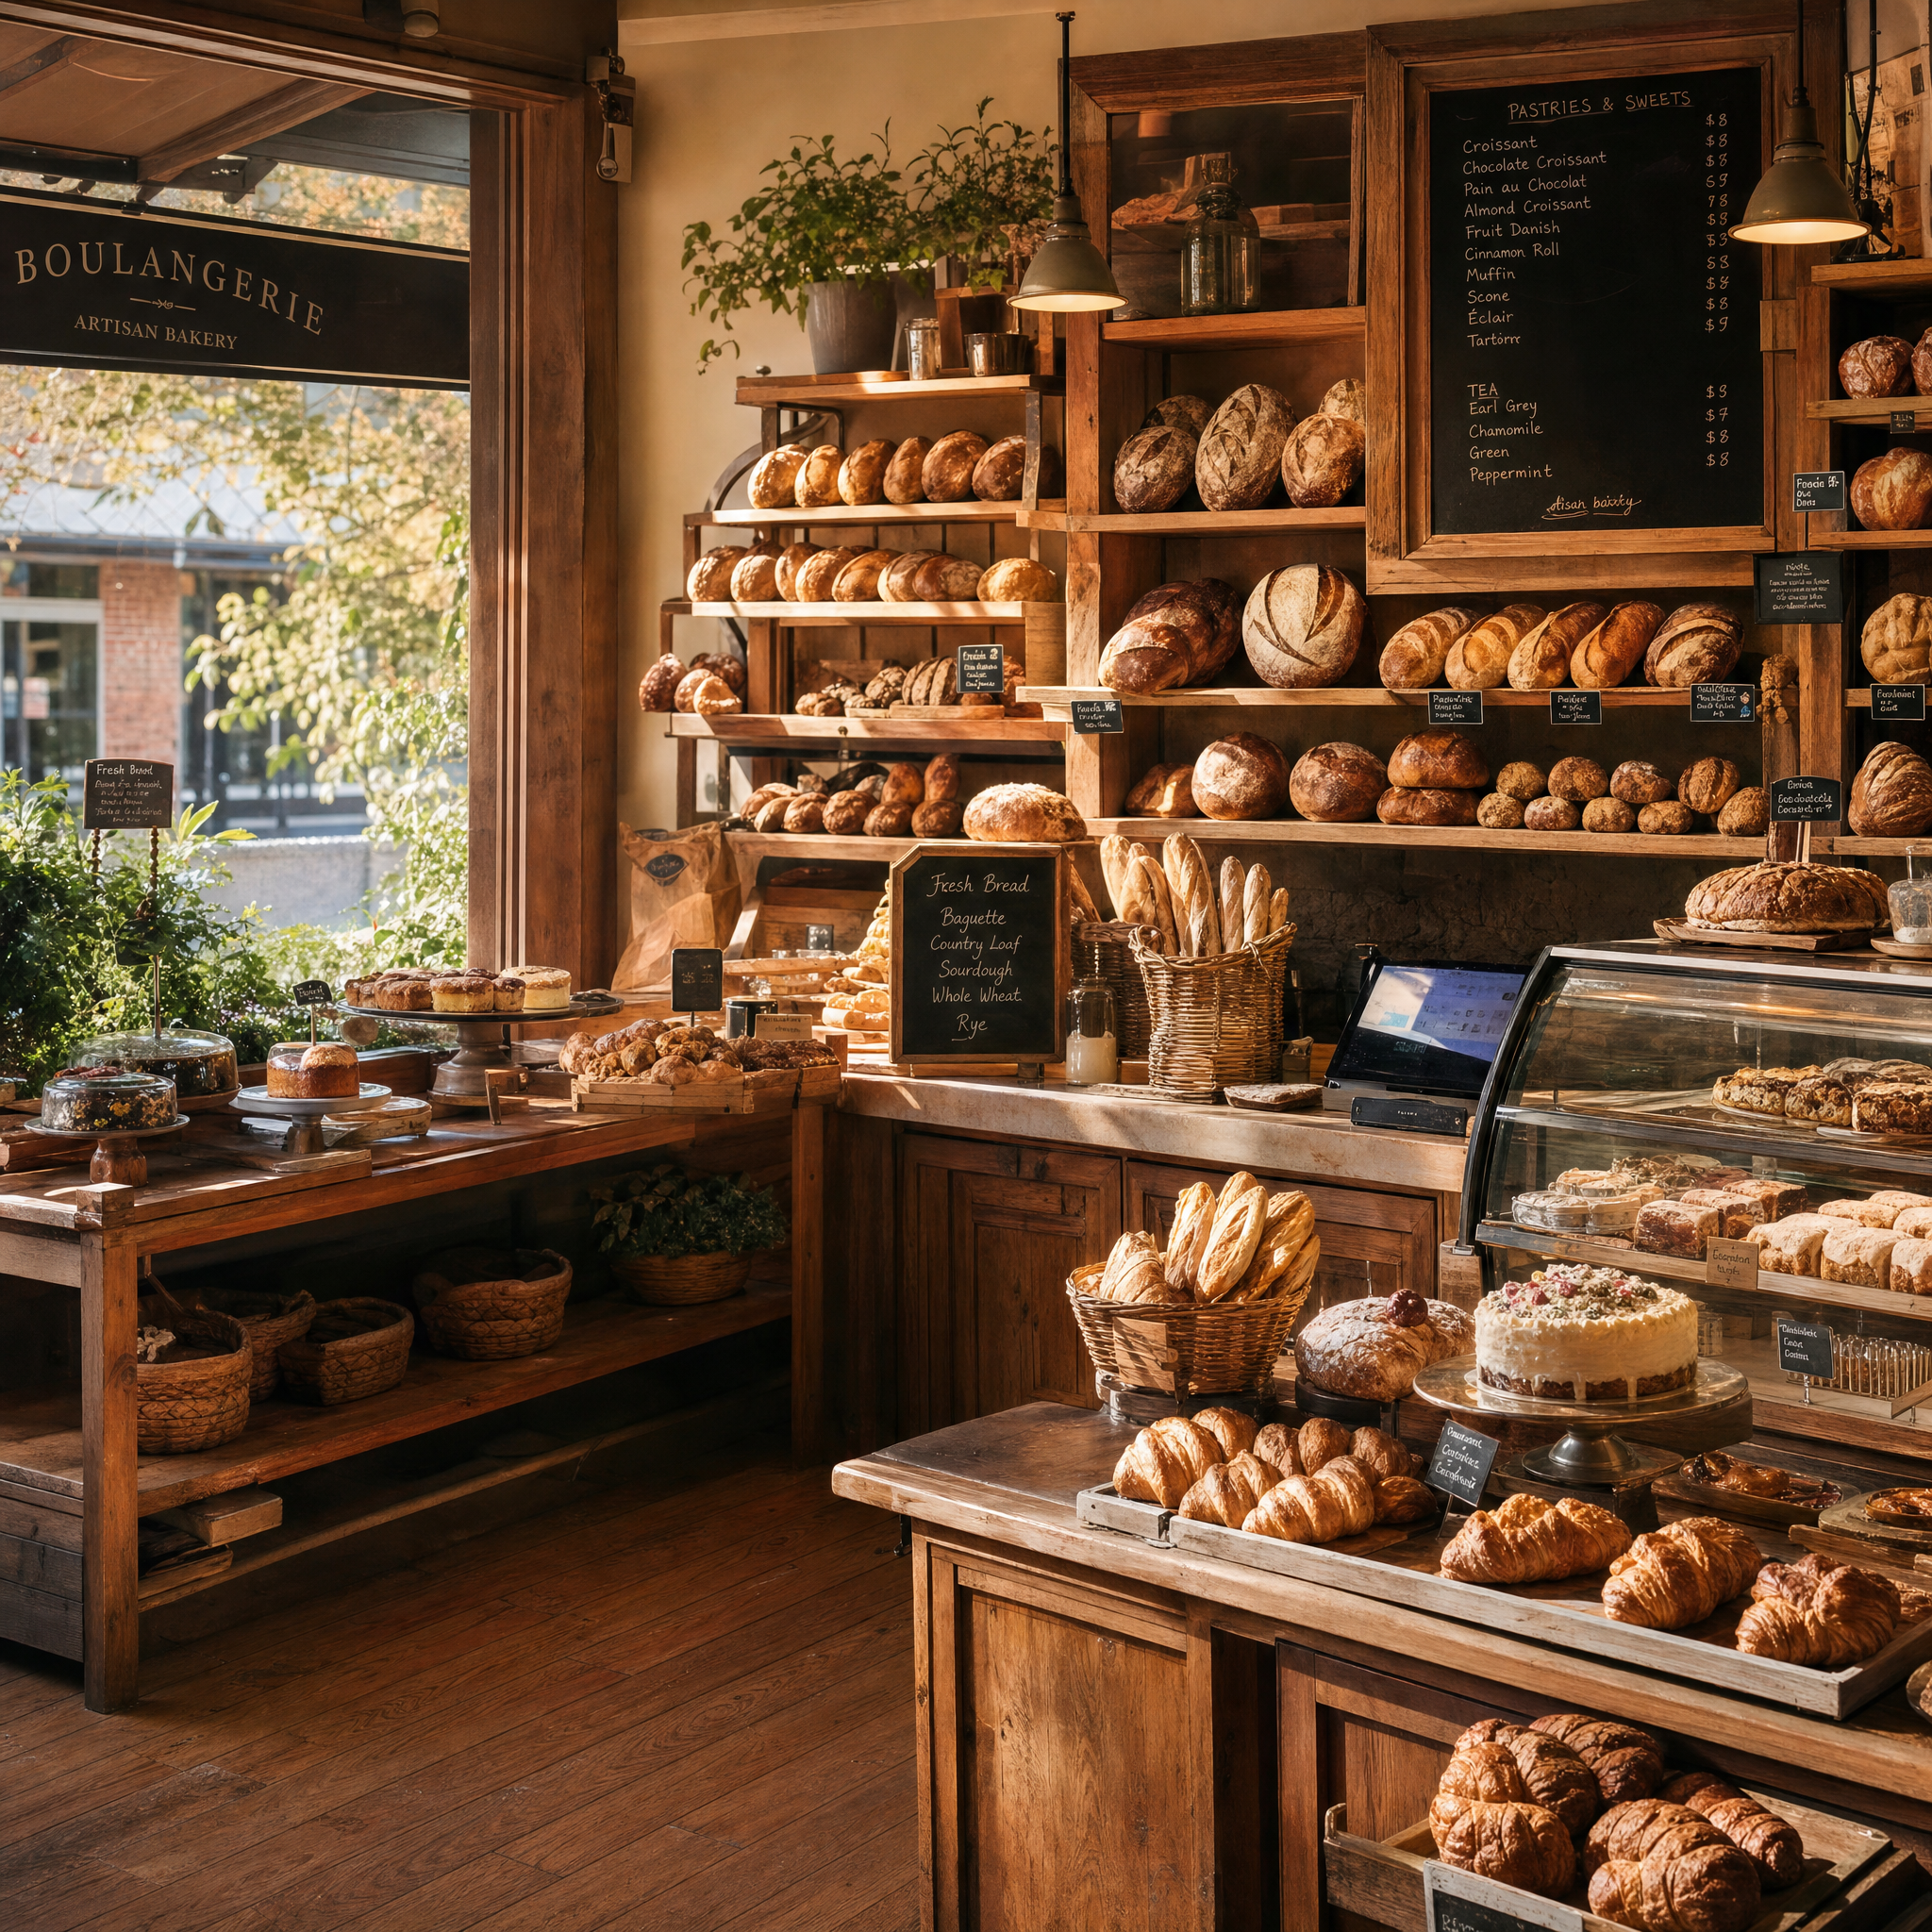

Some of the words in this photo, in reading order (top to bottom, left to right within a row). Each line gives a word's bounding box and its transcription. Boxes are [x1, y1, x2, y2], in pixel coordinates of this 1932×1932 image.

[1508, 98, 1591, 120] PASTRIES
[1604, 97, 1613, 110] &
[1625, 91, 1690, 110] SWEETS
[1463, 136, 1538, 153] Croissant
[1463, 158, 1529, 175] Chocolate
[1537, 151, 1607, 168] Croissant
[1465, 182, 1493, 196] Pain
[1502, 184, 1520, 192] au
[1529, 175, 1586, 192] Chocolat
[1464, 201, 1515, 217] Almond
[1524, 196, 1591, 213] Croissant
[1466, 225, 1502, 239] Fruit
[1510, 220, 1559, 236] Danish
[1465, 248, 1525, 260] Cinnamon
[1533, 242, 1558, 257] Roll
[1467, 267, 1515, 281] Muffin
[14, 242, 324, 336] BOULANGERIE
[1468, 291, 1509, 304] Scone
[1469, 308, 1513, 325] Éclair
[75, 315, 158, 339] ARTISAN
[166, 327, 237, 349] BAKERY
[1467, 382, 1499, 396] TEA
[1469, 399, 1497, 415] Earl
[1507, 399, 1536, 419] Grey
[1470, 421, 1543, 438] Chamomile
[1470, 446, 1509, 458] Green
[1470, 465, 1552, 485] Peppermint
[96, 763, 125, 774] Fresh
[926, 873, 974, 897] Fresh
[984, 874, 1029, 892] Bread
[941, 907, 1006, 933] Baguette
[931, 935, 983, 959] Country
[990, 935, 1022, 954] Loaf
[940, 960, 1012, 986] Sourdough
[933, 987, 972, 1003] Whole
[980, 987, 1022, 1002] Wheat
[957, 1014, 988, 1040] Rye
